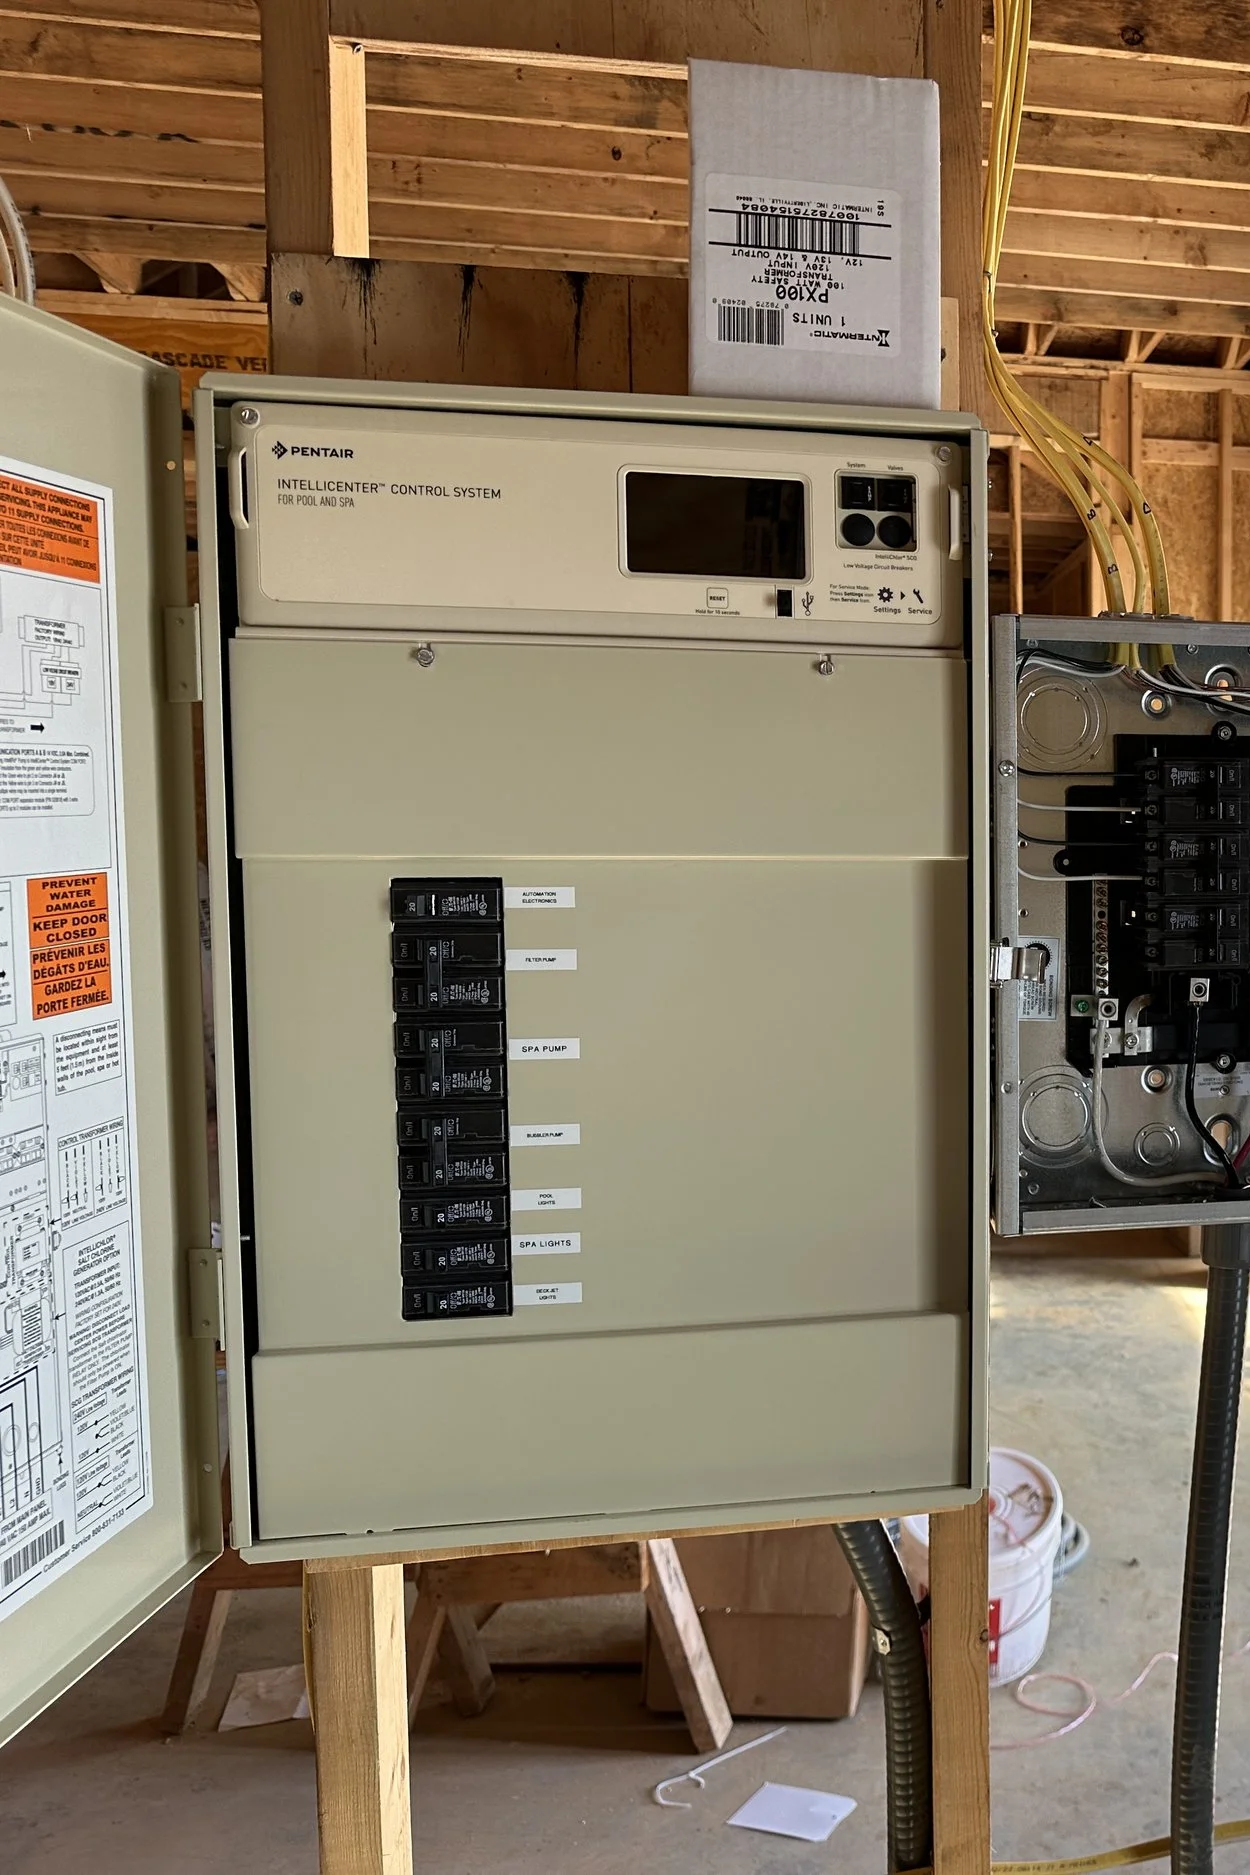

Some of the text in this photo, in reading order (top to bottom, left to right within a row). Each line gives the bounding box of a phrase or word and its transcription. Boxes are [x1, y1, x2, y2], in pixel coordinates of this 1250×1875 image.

[741, 203, 860, 220] 10078275154084
[732, 249, 770, 258] OUTPUT
[776, 252, 793, 260] 14V
[768, 260, 829, 271] 120V INPUT
[814, 256, 831, 264] 13V
[764, 268, 832, 280] TRANSFORMER
[751, 275, 789, 285] SAFETY
[796, 280, 821, 288] WATT
[776, 285, 829, 303] PX100
[792, 312, 846, 327] 1 UNITS
[291, 446, 354, 458] PENTAIR
[390, 484, 449, 498] CONTROL
[453, 487, 501, 499] SYSTEM
[12, 484, 23, 493] ALL
[25, 487, 47, 500] SUPPLY
[49, 494, 90, 511] CONNECTIONS
[278, 495, 355, 508] FOR POOL AND SPA
[16, 509, 39, 521] SUPPLY
[32, 502, 46, 512] THIS
[48, 506, 79, 520] APPLIANCE
[873, 606, 901, 614] Settings
[42, 877, 97, 889] PREVENT
[50, 889, 91, 900] WATER
[46, 900, 95, 912] DAMAGE
[409, 902, 416, 912] 20
[33, 913, 107, 931] KEEP DOOR
[46, 927, 97, 943] CLOSED
[88, 943, 106, 954] LES
[430, 946, 436, 956] 20
[33, 962, 75, 980] DÉGÂTS
[45, 976, 96, 996] GARDEZ LA
[431, 992, 437, 1002] 20
[37, 998, 68, 1015] PORTE
[431, 1038, 438, 1048] 20
[432, 1082, 439, 1092] 20
[434, 1126, 442, 1136] 20
[436, 1170, 443, 1179] 20
[438, 1213, 445, 1223] 20
[439, 1257, 446, 1266] 20
[440, 1300, 447, 1309] 20
[43, 1549, 70, 1573] Customer
[72, 1534, 91, 1552] Service
